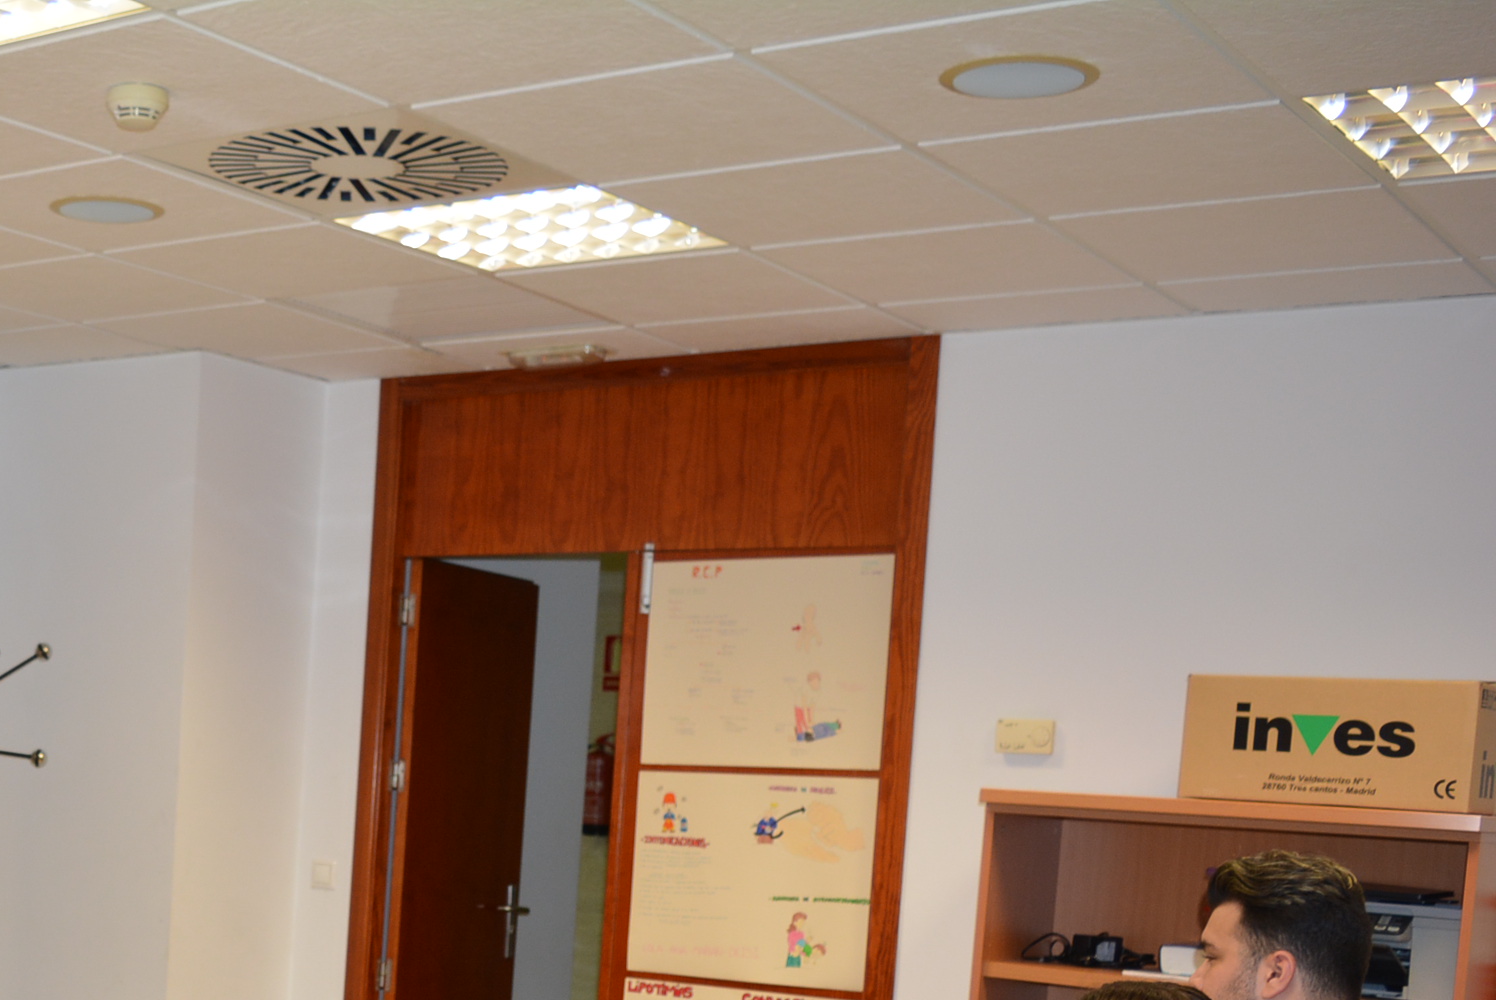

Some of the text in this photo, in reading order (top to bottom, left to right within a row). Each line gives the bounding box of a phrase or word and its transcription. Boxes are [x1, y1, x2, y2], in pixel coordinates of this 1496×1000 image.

[1233, 702, 1416, 758] inves
[1267, 773, 1296, 782] Ronda
[1262, 782, 1287, 791] 28760
[1289, 783, 1307, 792] Tres
[1309, 785, 1338, 794] cantos
[1345, 787, 1377, 796] Madrid
